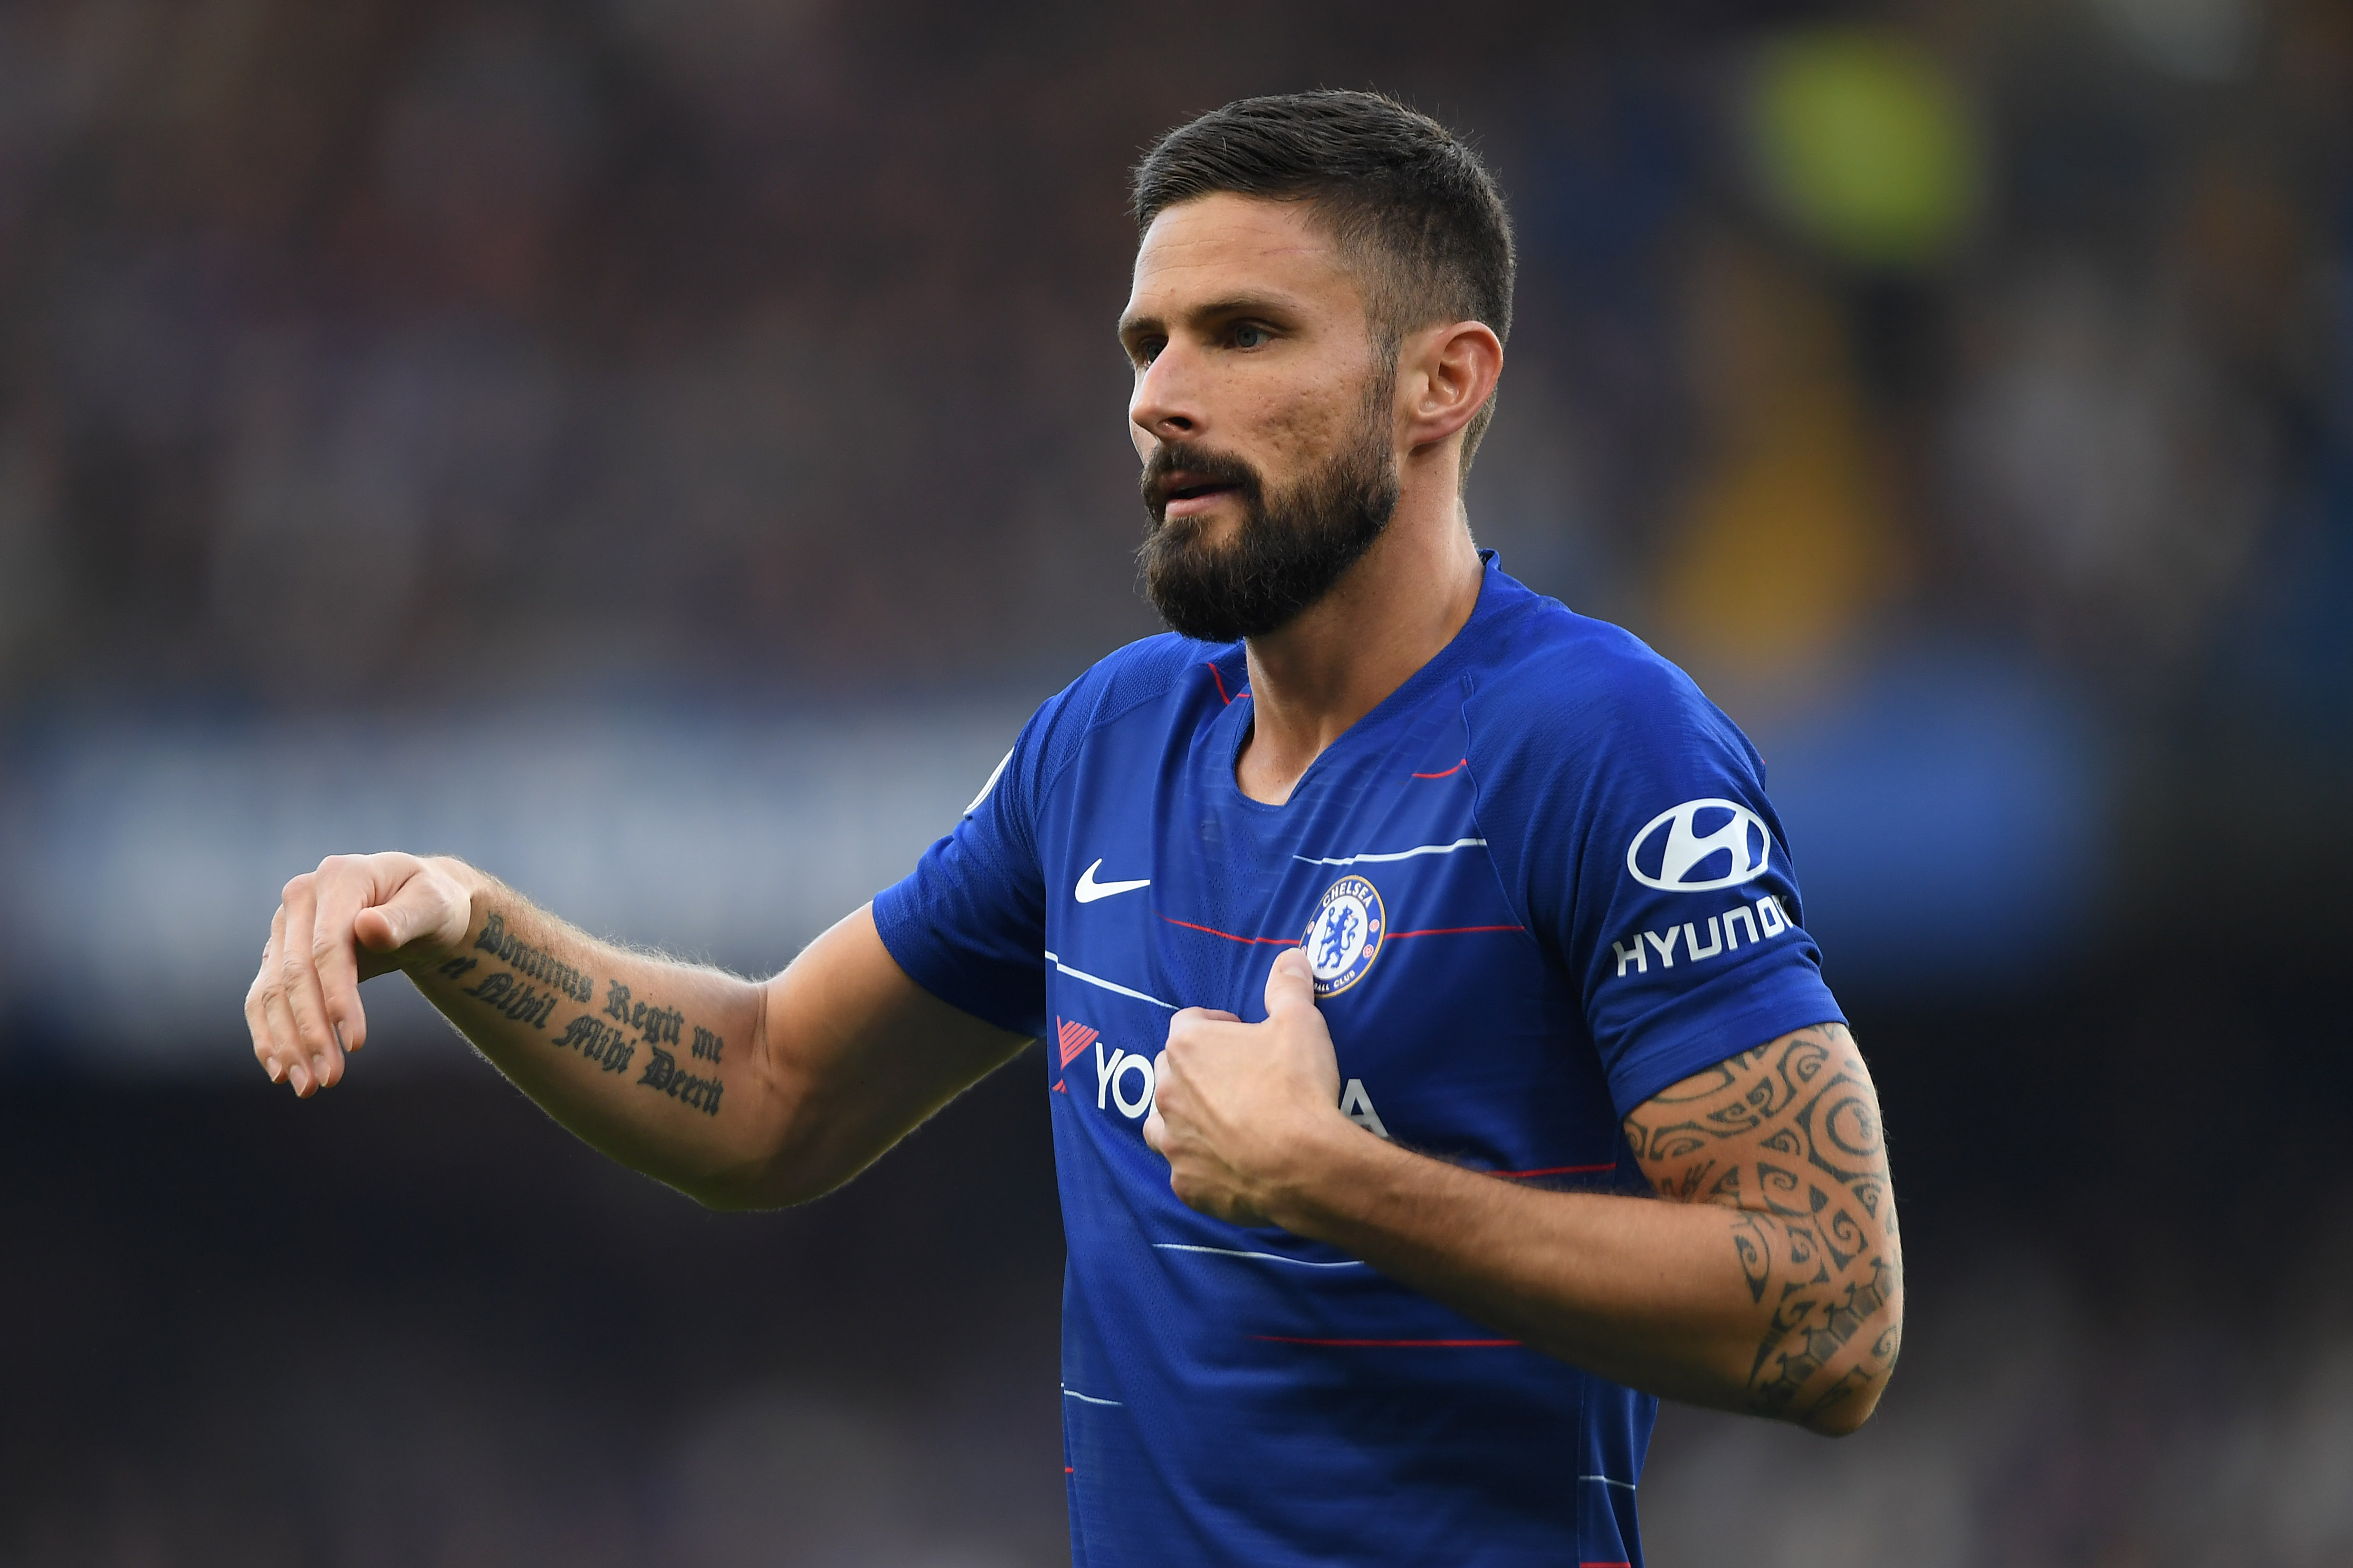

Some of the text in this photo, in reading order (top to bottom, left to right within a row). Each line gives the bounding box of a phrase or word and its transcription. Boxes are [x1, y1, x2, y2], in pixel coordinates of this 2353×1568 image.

[1323, 881, 1374, 908] CHELSEA
[1333, 970, 1355, 988] CLUB
[603, 979, 684, 1046] Regit
[692, 1026, 723, 1064] me
